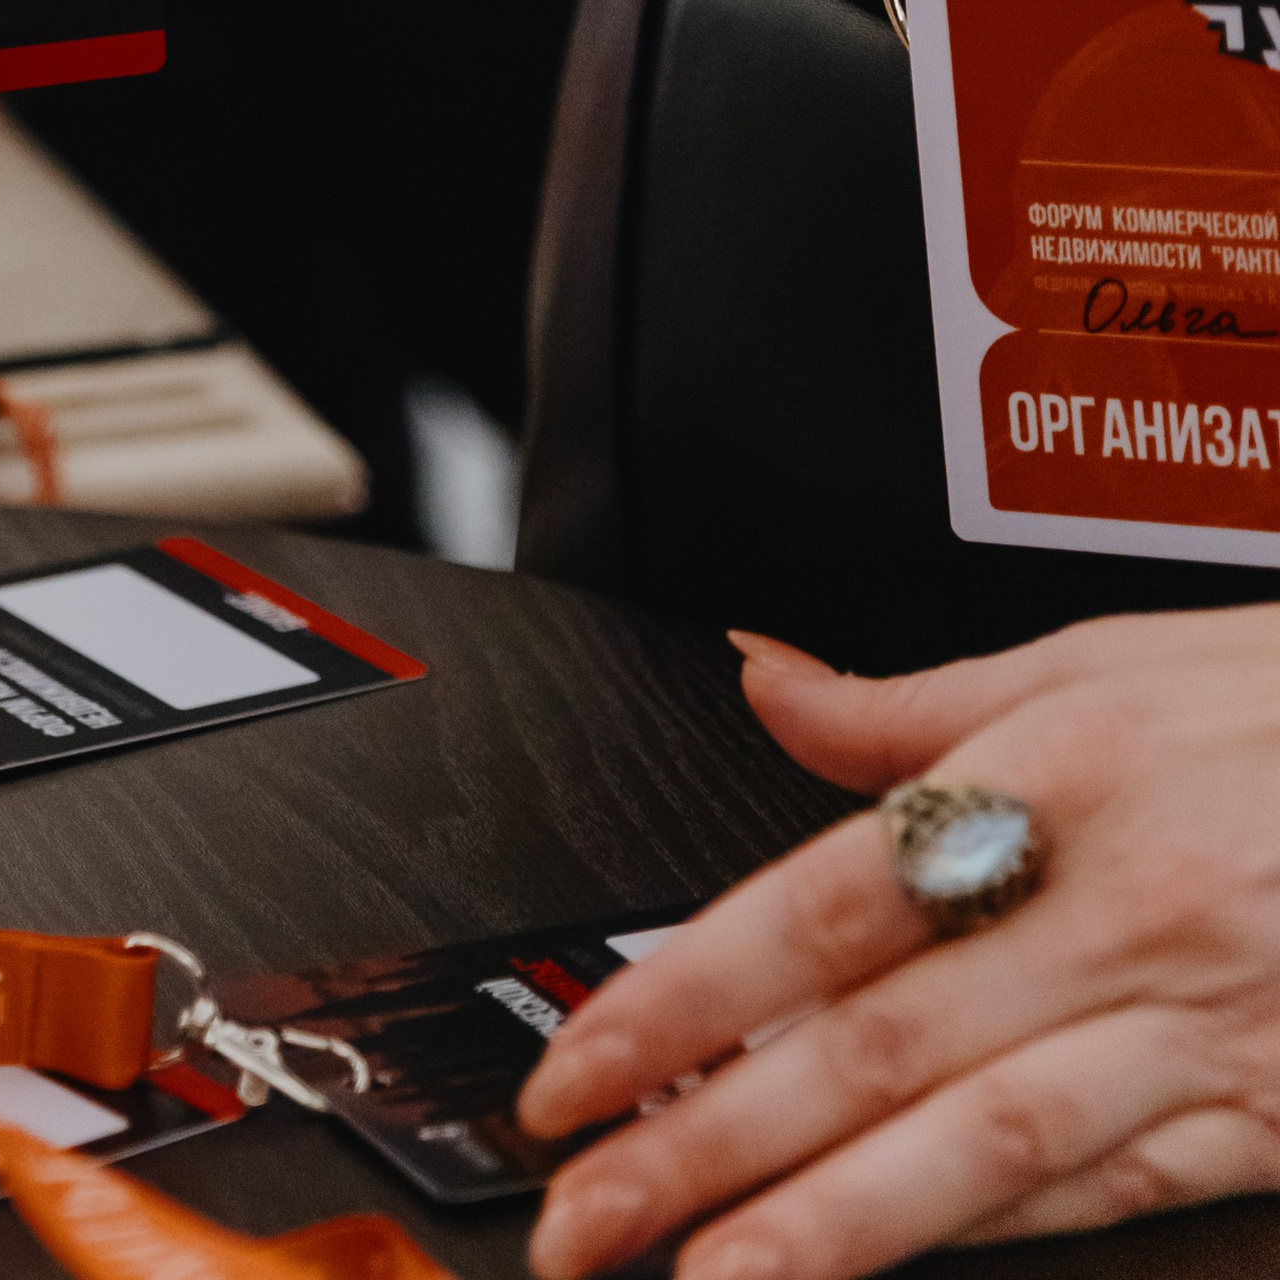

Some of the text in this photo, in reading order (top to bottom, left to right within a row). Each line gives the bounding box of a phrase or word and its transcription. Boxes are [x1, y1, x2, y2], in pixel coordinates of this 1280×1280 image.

[1028, 202, 1279, 240] ФОРУМ КОММЕРЧЕСКОЙ
[1030, 235, 1202, 270] НЕДВИЖИМОСТИ
[1083, 277, 1278, 339] Ольга
